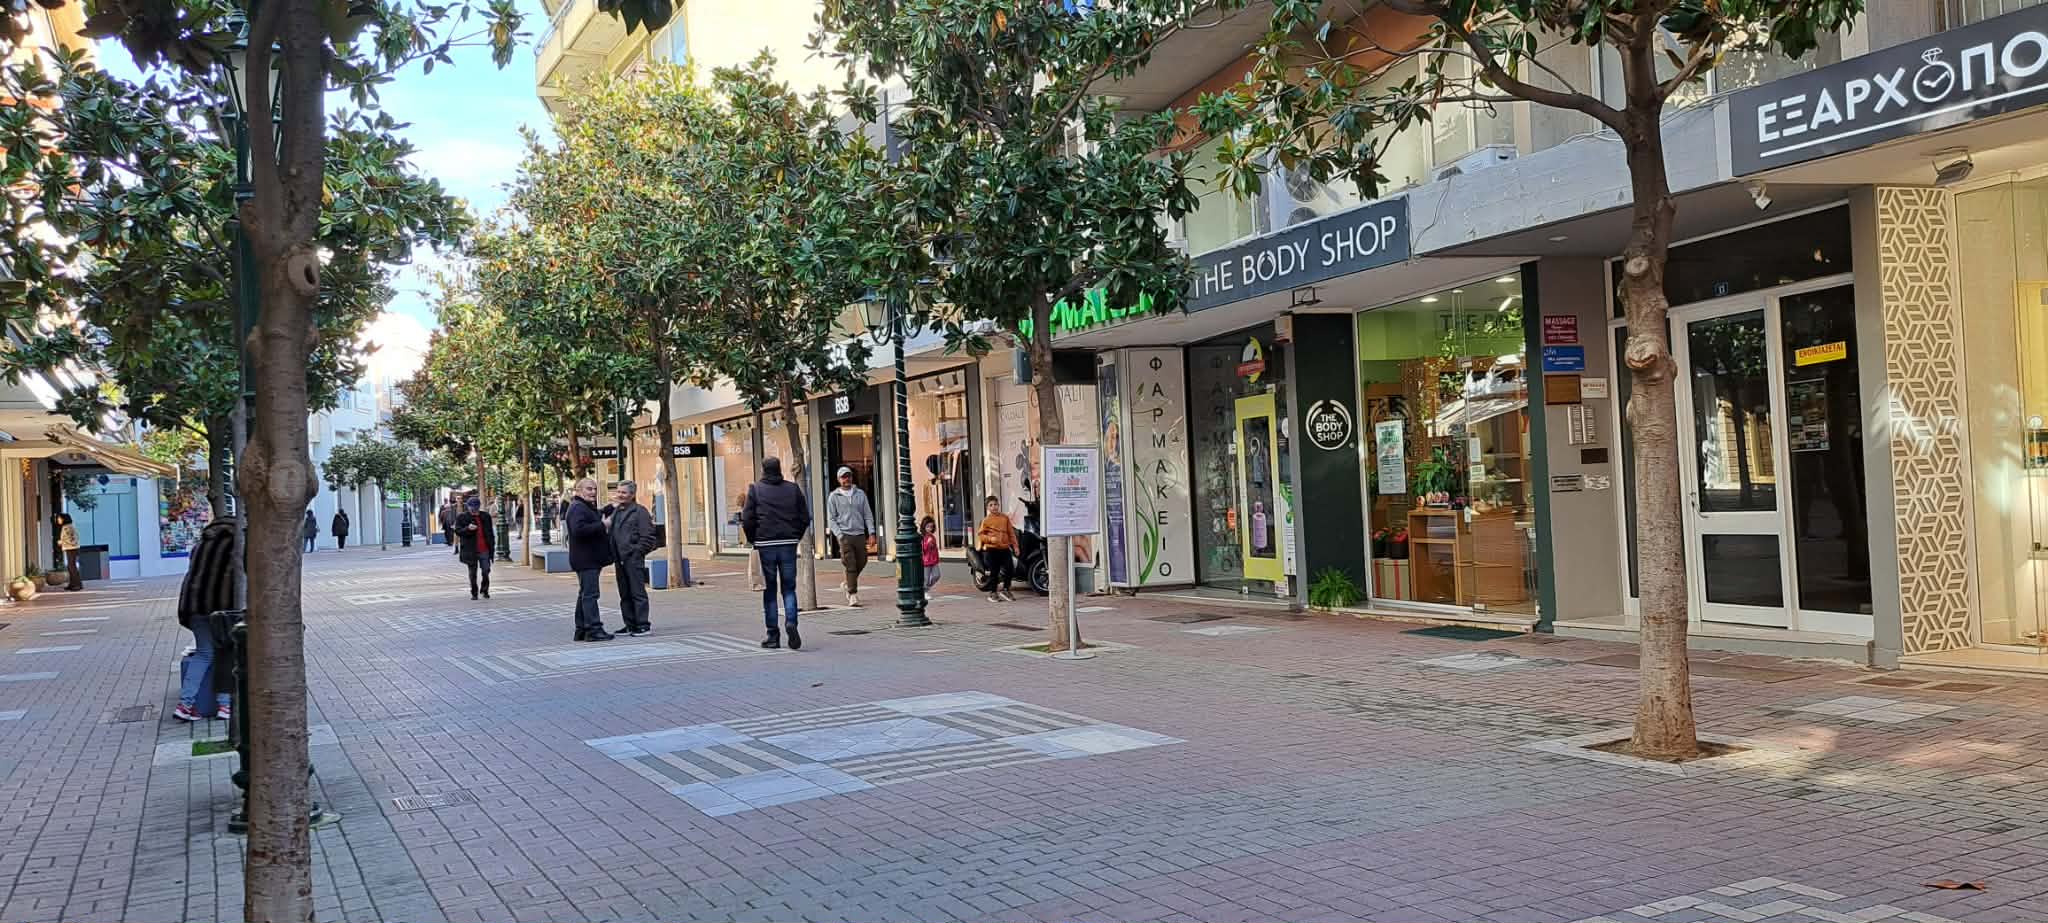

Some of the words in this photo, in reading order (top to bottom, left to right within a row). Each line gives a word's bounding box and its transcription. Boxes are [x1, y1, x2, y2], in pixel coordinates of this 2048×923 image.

[1194, 260, 1234, 298] THE
[1242, 238, 1310, 286] BODY
[1321, 215, 1397, 267] SHOP
[835, 395, 849, 415] BSB
[1320, 413, 1337, 422] THE
[1315, 422, 1343, 433] BODY
[1317, 431, 1343, 442] SHOP
[674, 446, 691, 455] BSB
[1149, 356, 1172, 577] ΦΑΡΜΑΚΕΙΟ
